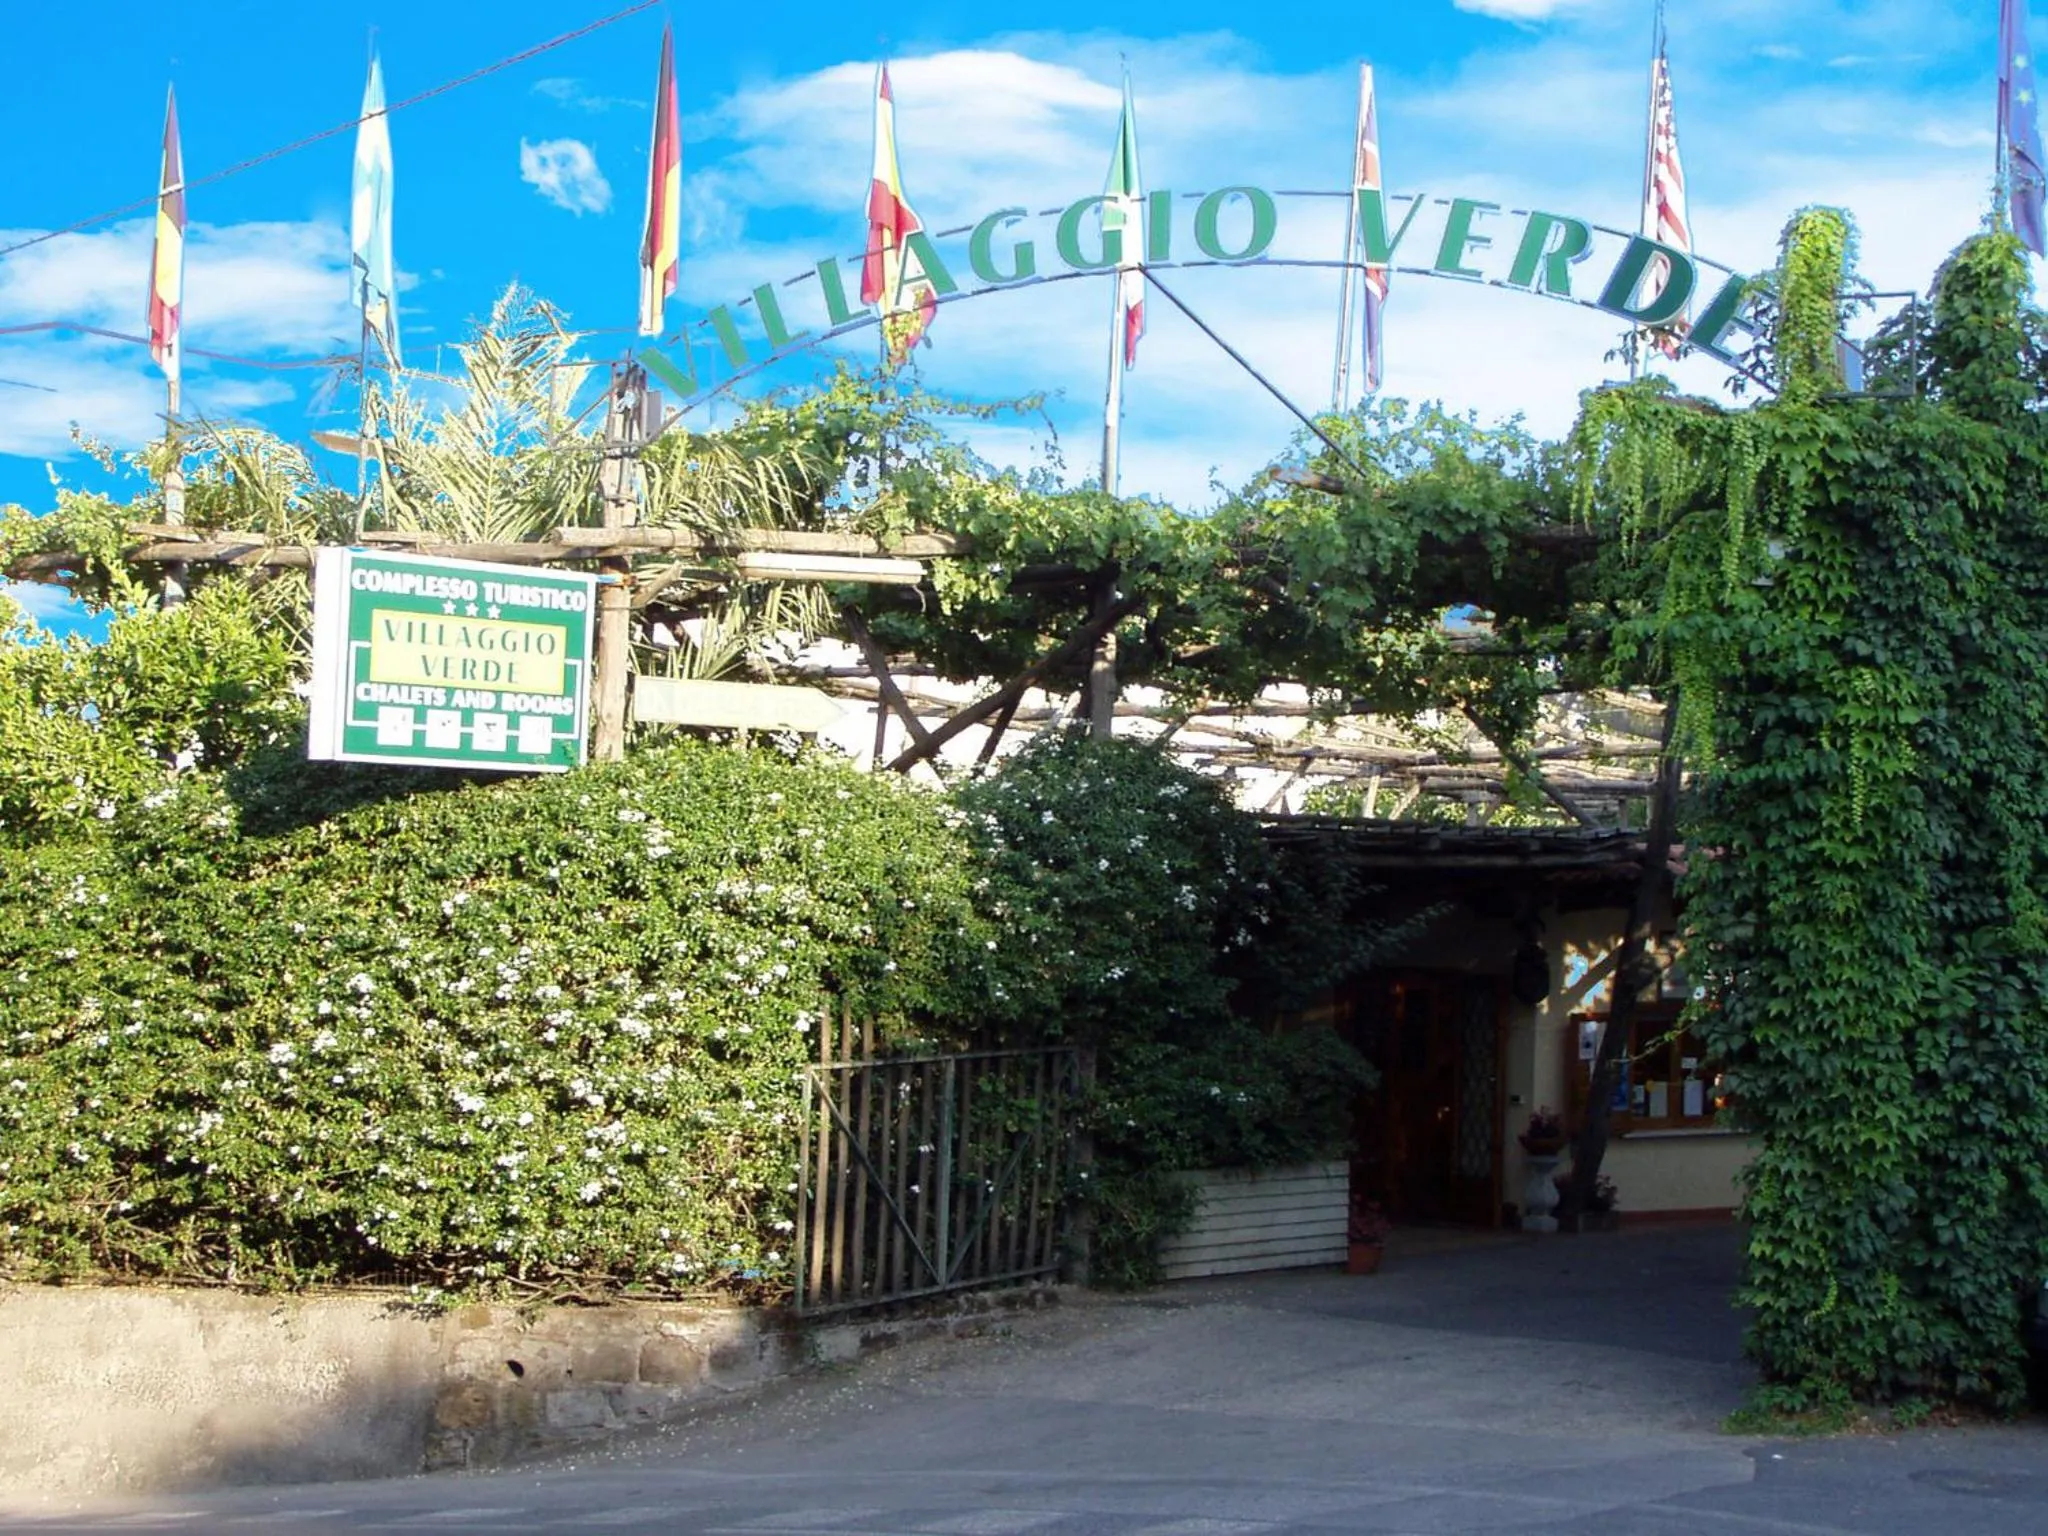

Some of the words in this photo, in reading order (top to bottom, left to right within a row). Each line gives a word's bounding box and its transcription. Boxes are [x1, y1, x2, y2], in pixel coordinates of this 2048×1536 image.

[636, 186, 1277, 399] VILLAGGIO
[1357, 189, 1775, 364] VERDE
[352, 568, 477, 601] COMPLESSO
[483, 581, 586, 611] TURISTICO
[385, 619, 556, 655] VILLAGGIO
[421, 655, 519, 684] VERDE
[356, 683, 446, 706] CHALETS
[452, 689, 496, 710] AND
[501, 693, 574, 716] ROOMS
